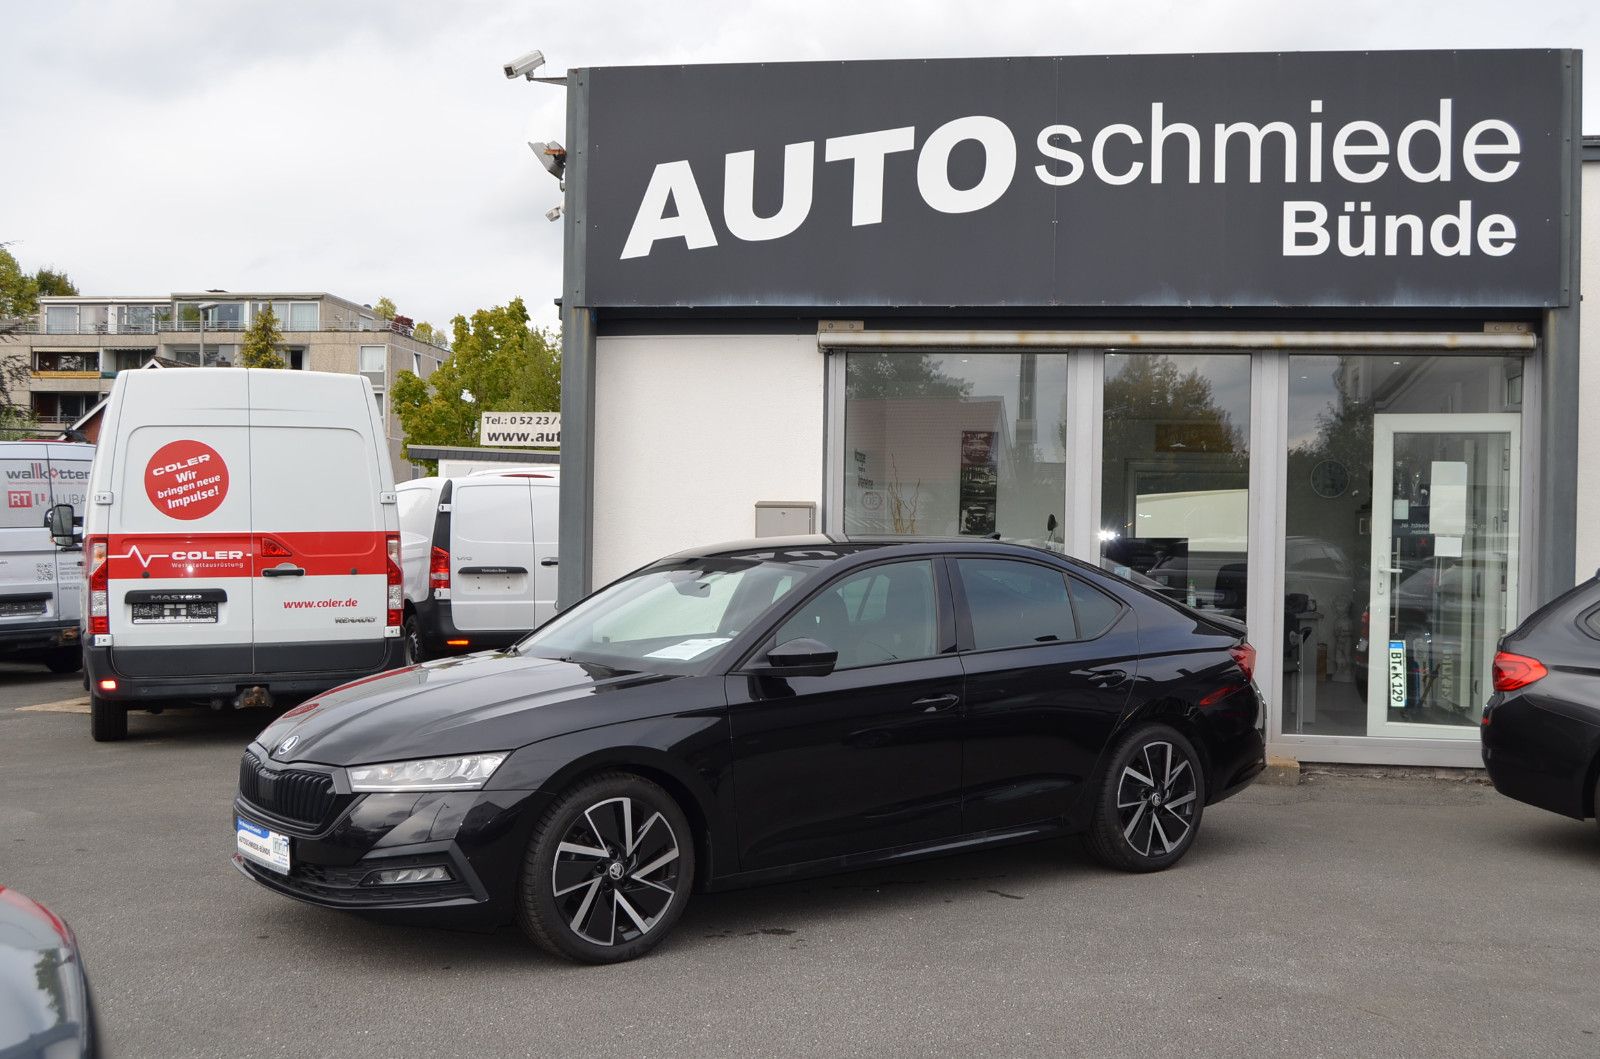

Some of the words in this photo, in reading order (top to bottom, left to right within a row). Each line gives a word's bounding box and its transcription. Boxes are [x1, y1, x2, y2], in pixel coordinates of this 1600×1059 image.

[1281, 199, 1517, 257] Bünde
[485, 416, 507, 425] Tel.:
[152, 453, 211, 476] COLER
[157, 481, 195, 499] bringen
[196, 474, 221, 488] neue
[175, 470, 197, 483] Wir
[167, 485, 219, 509] Impulse!
[171, 551, 244, 560] COLER
[283, 598, 358, 609] www.coler.de
[1392, 682, 1403, 703] 129
